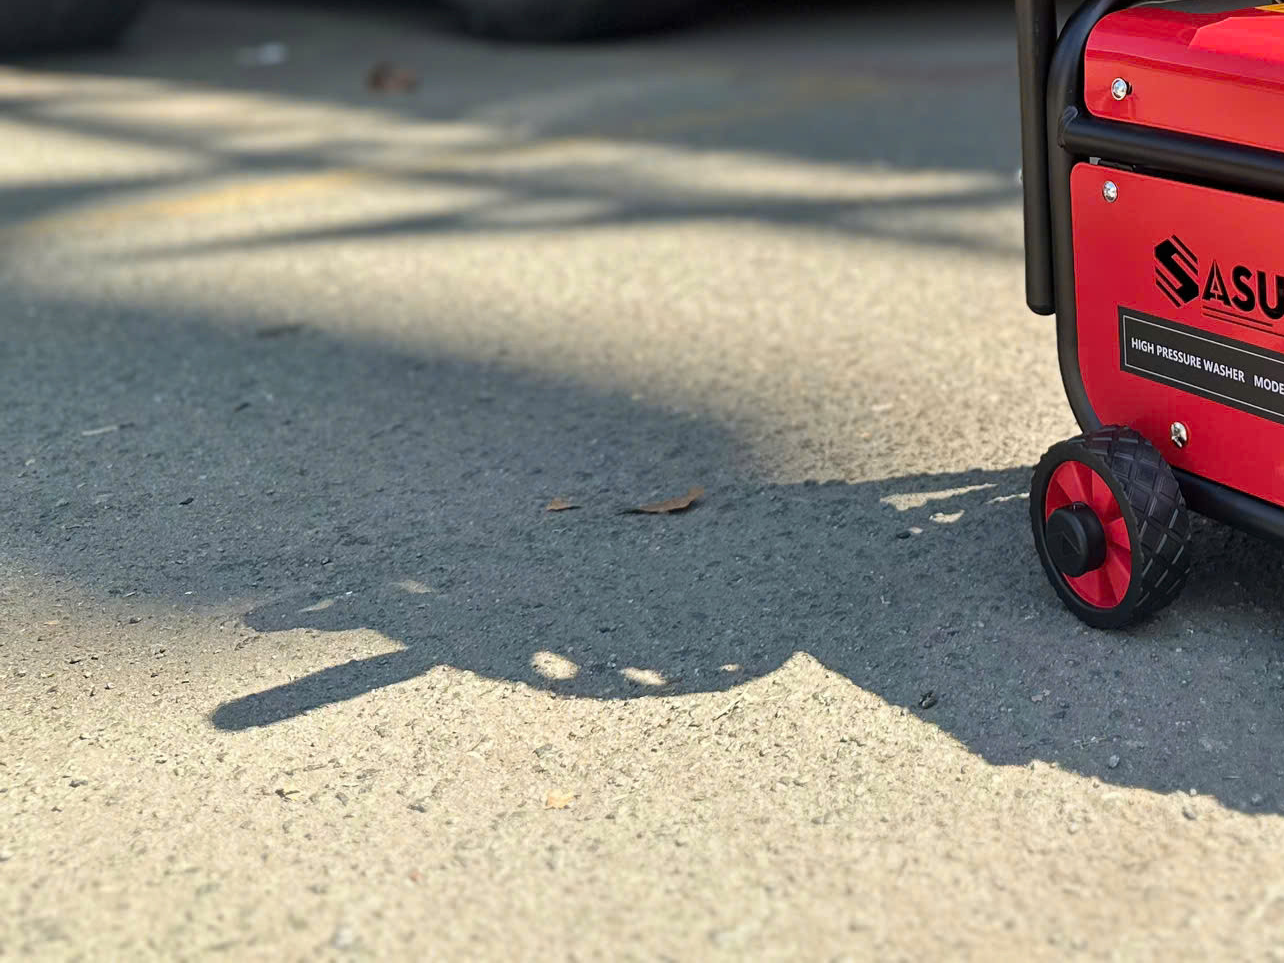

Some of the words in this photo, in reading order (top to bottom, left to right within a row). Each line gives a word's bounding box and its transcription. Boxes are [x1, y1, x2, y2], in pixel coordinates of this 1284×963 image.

[1131, 337, 1155, 355] HIGH
[1157, 345, 1202, 369] PRESSURE
[1203, 362, 1245, 383] WASHER
